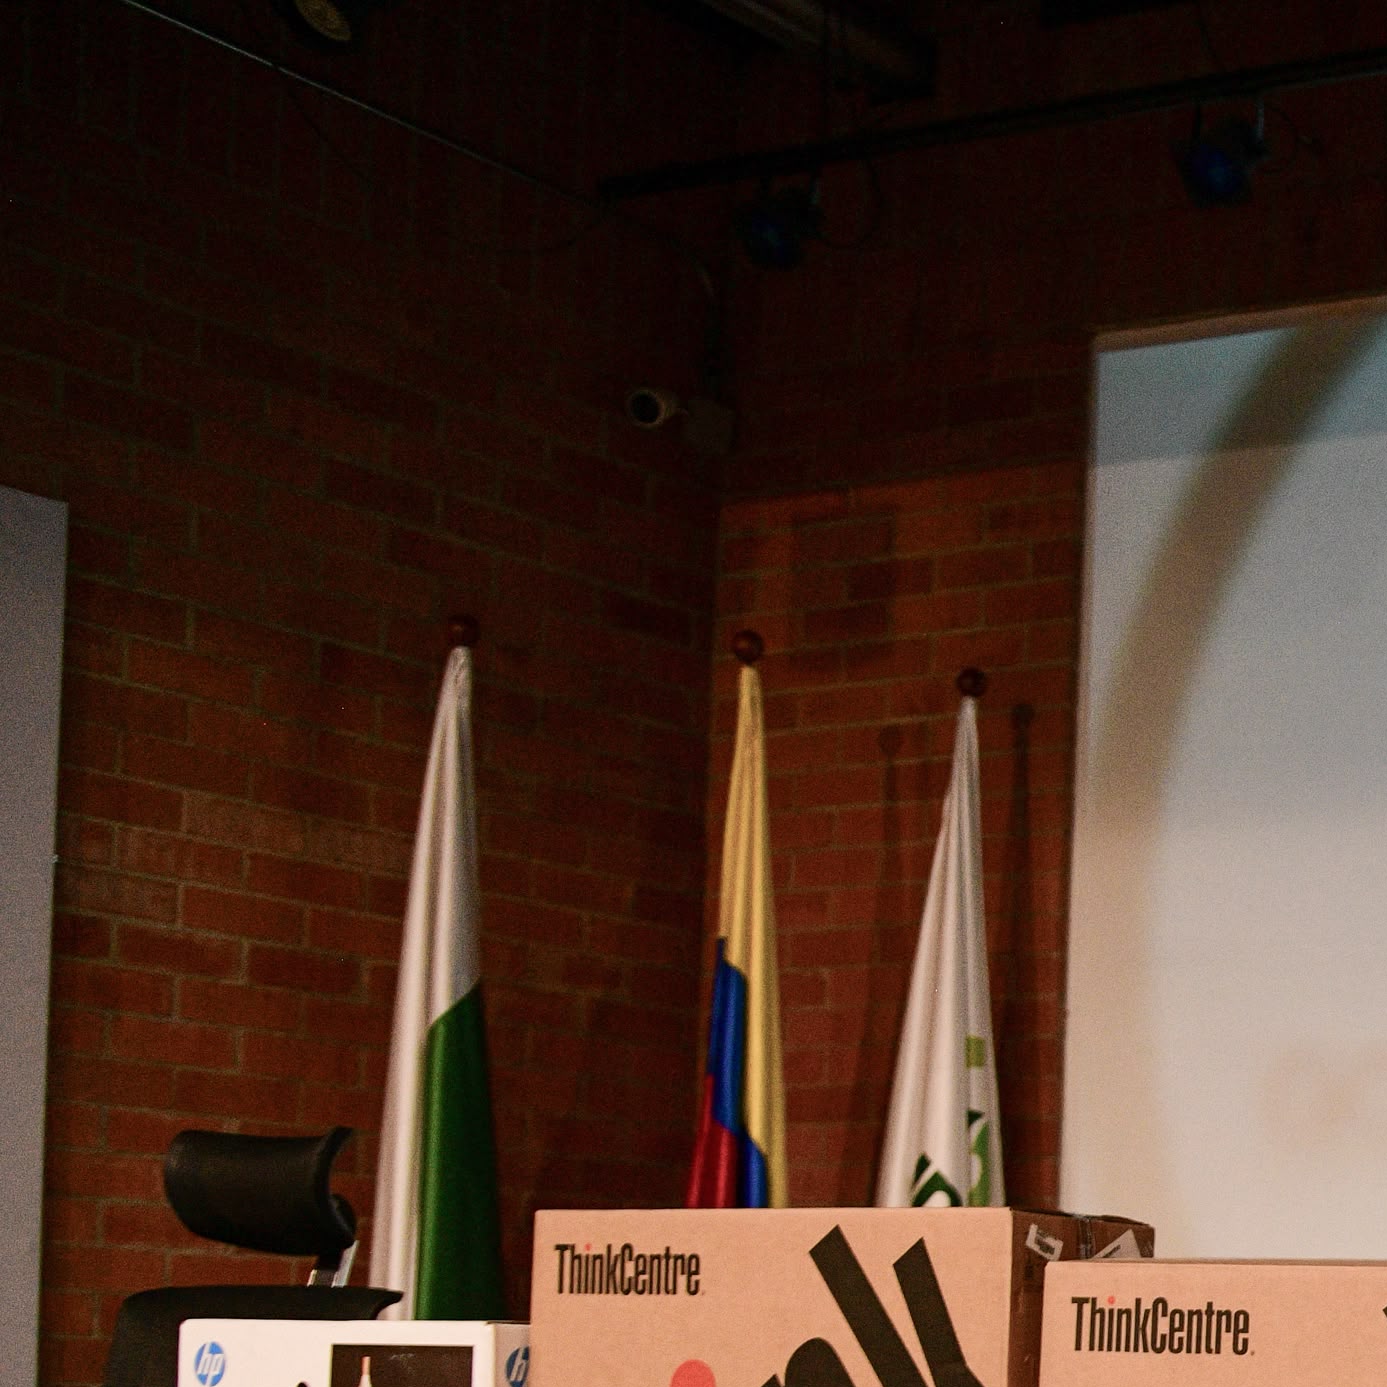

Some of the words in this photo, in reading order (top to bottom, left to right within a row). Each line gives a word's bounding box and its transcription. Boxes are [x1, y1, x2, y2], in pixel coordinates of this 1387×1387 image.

[555, 1242, 701, 1296] ThinkCentre
[1071, 1295, 1250, 1355] ThinkCentre
[194, 1342, 226, 1387] hp
